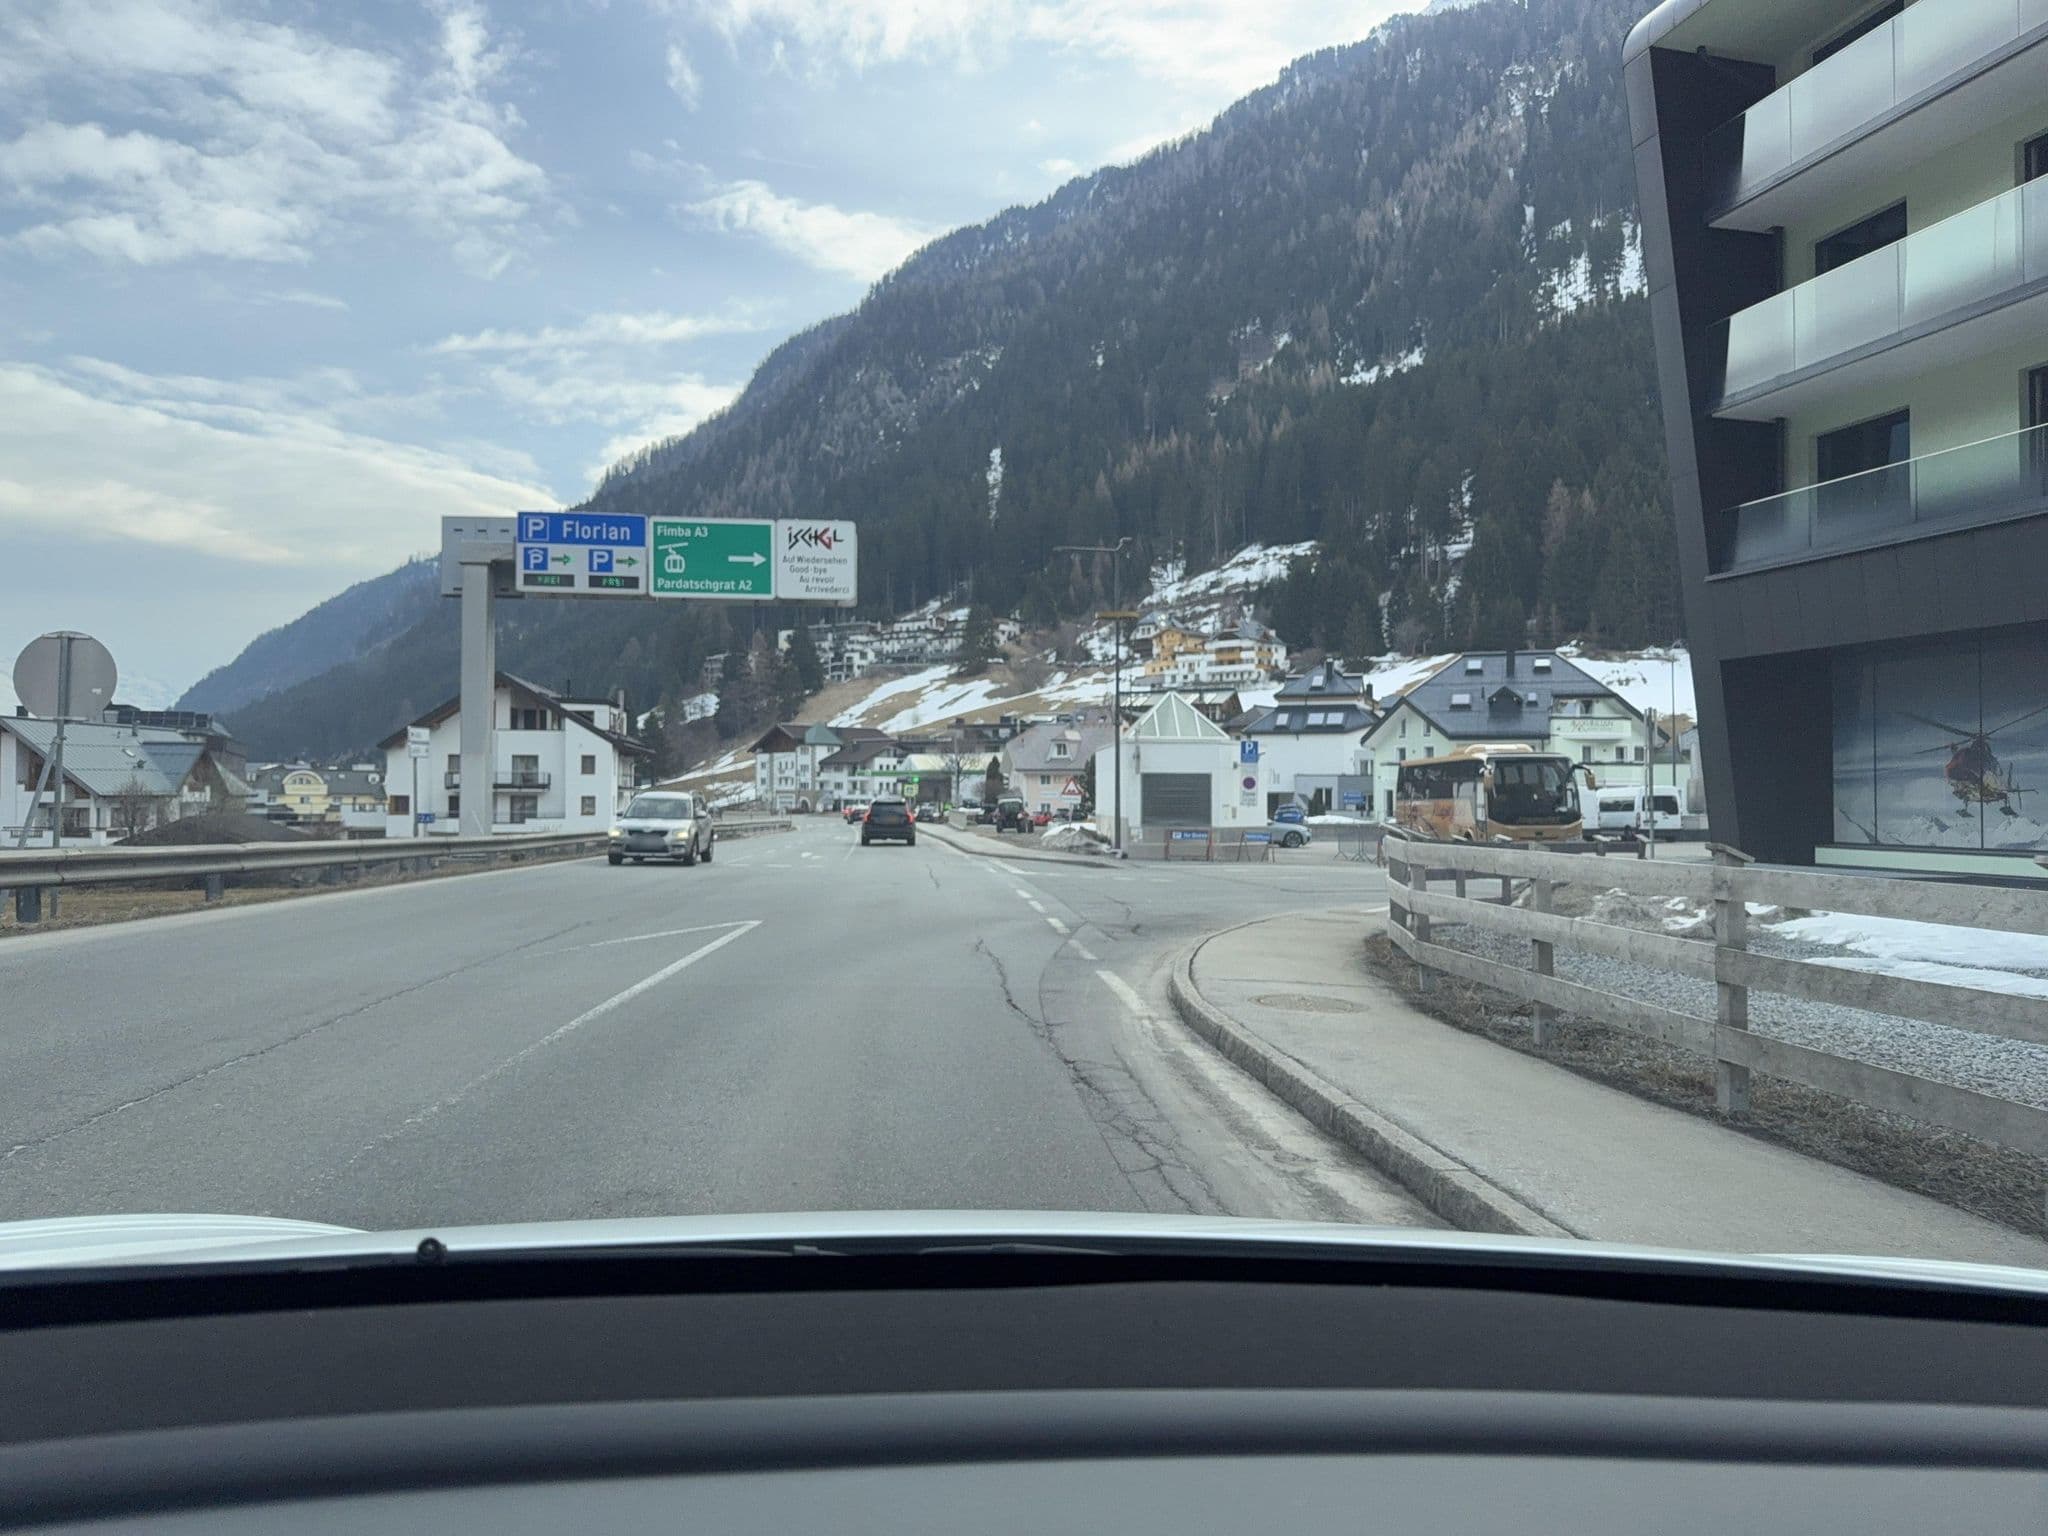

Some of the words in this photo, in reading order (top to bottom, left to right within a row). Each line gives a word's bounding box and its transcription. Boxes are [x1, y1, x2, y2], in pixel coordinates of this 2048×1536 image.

[528, 519, 545, 539] P
[562, 520, 631, 541] Florian
[657, 525, 691, 537] Fimba
[694, 526, 708, 538] A3
[530, 553, 544, 570] P
[593, 551, 609, 571] P
[782, 555, 795, 563] Auf
[797, 555, 848, 564] Wiedersehen
[657, 578, 735, 592] Pardatschgrat
[738, 580, 752, 591] A2
[1245, 742, 1254, 754] P
